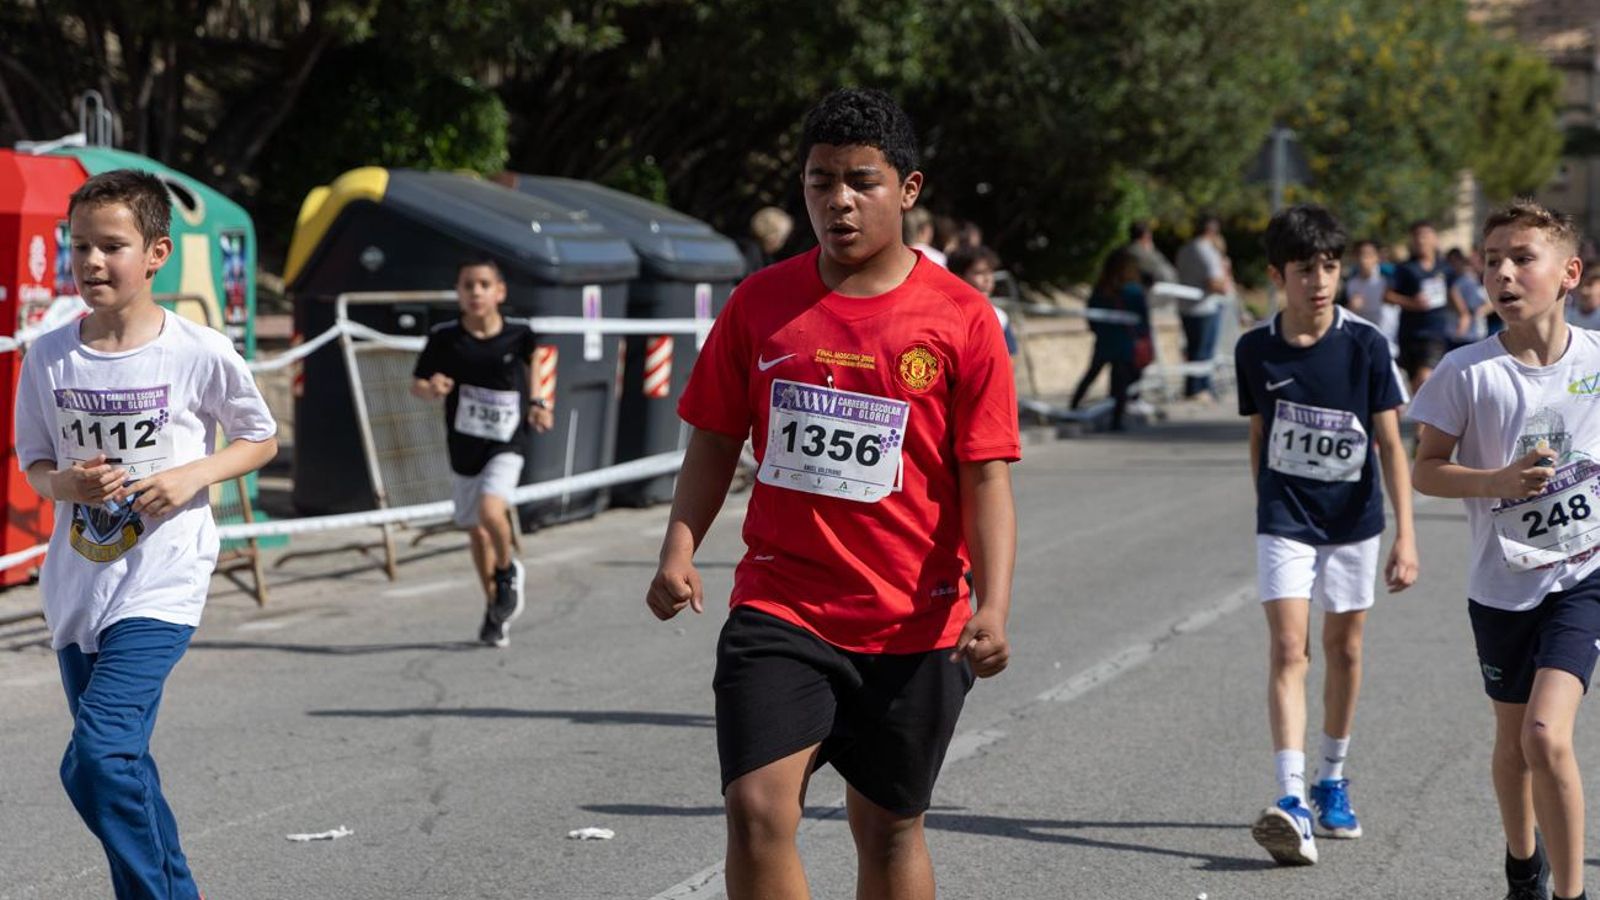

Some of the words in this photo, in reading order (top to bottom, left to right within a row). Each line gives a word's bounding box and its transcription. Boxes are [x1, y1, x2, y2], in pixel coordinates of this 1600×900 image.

[112, 400, 123, 410] LA
[128, 399, 157, 409] GLORIA
[837, 396, 869, 410] CARRERA
[870, 402, 901, 416] ESCOLAR
[842, 406, 853, 417] LA
[858, 409, 891, 423] GLORIA
[71, 419, 156, 450] 1112
[782, 421, 881, 467] 1356
[1283, 430, 1352, 460] 1106
[1522, 494, 1591, 539] 248
